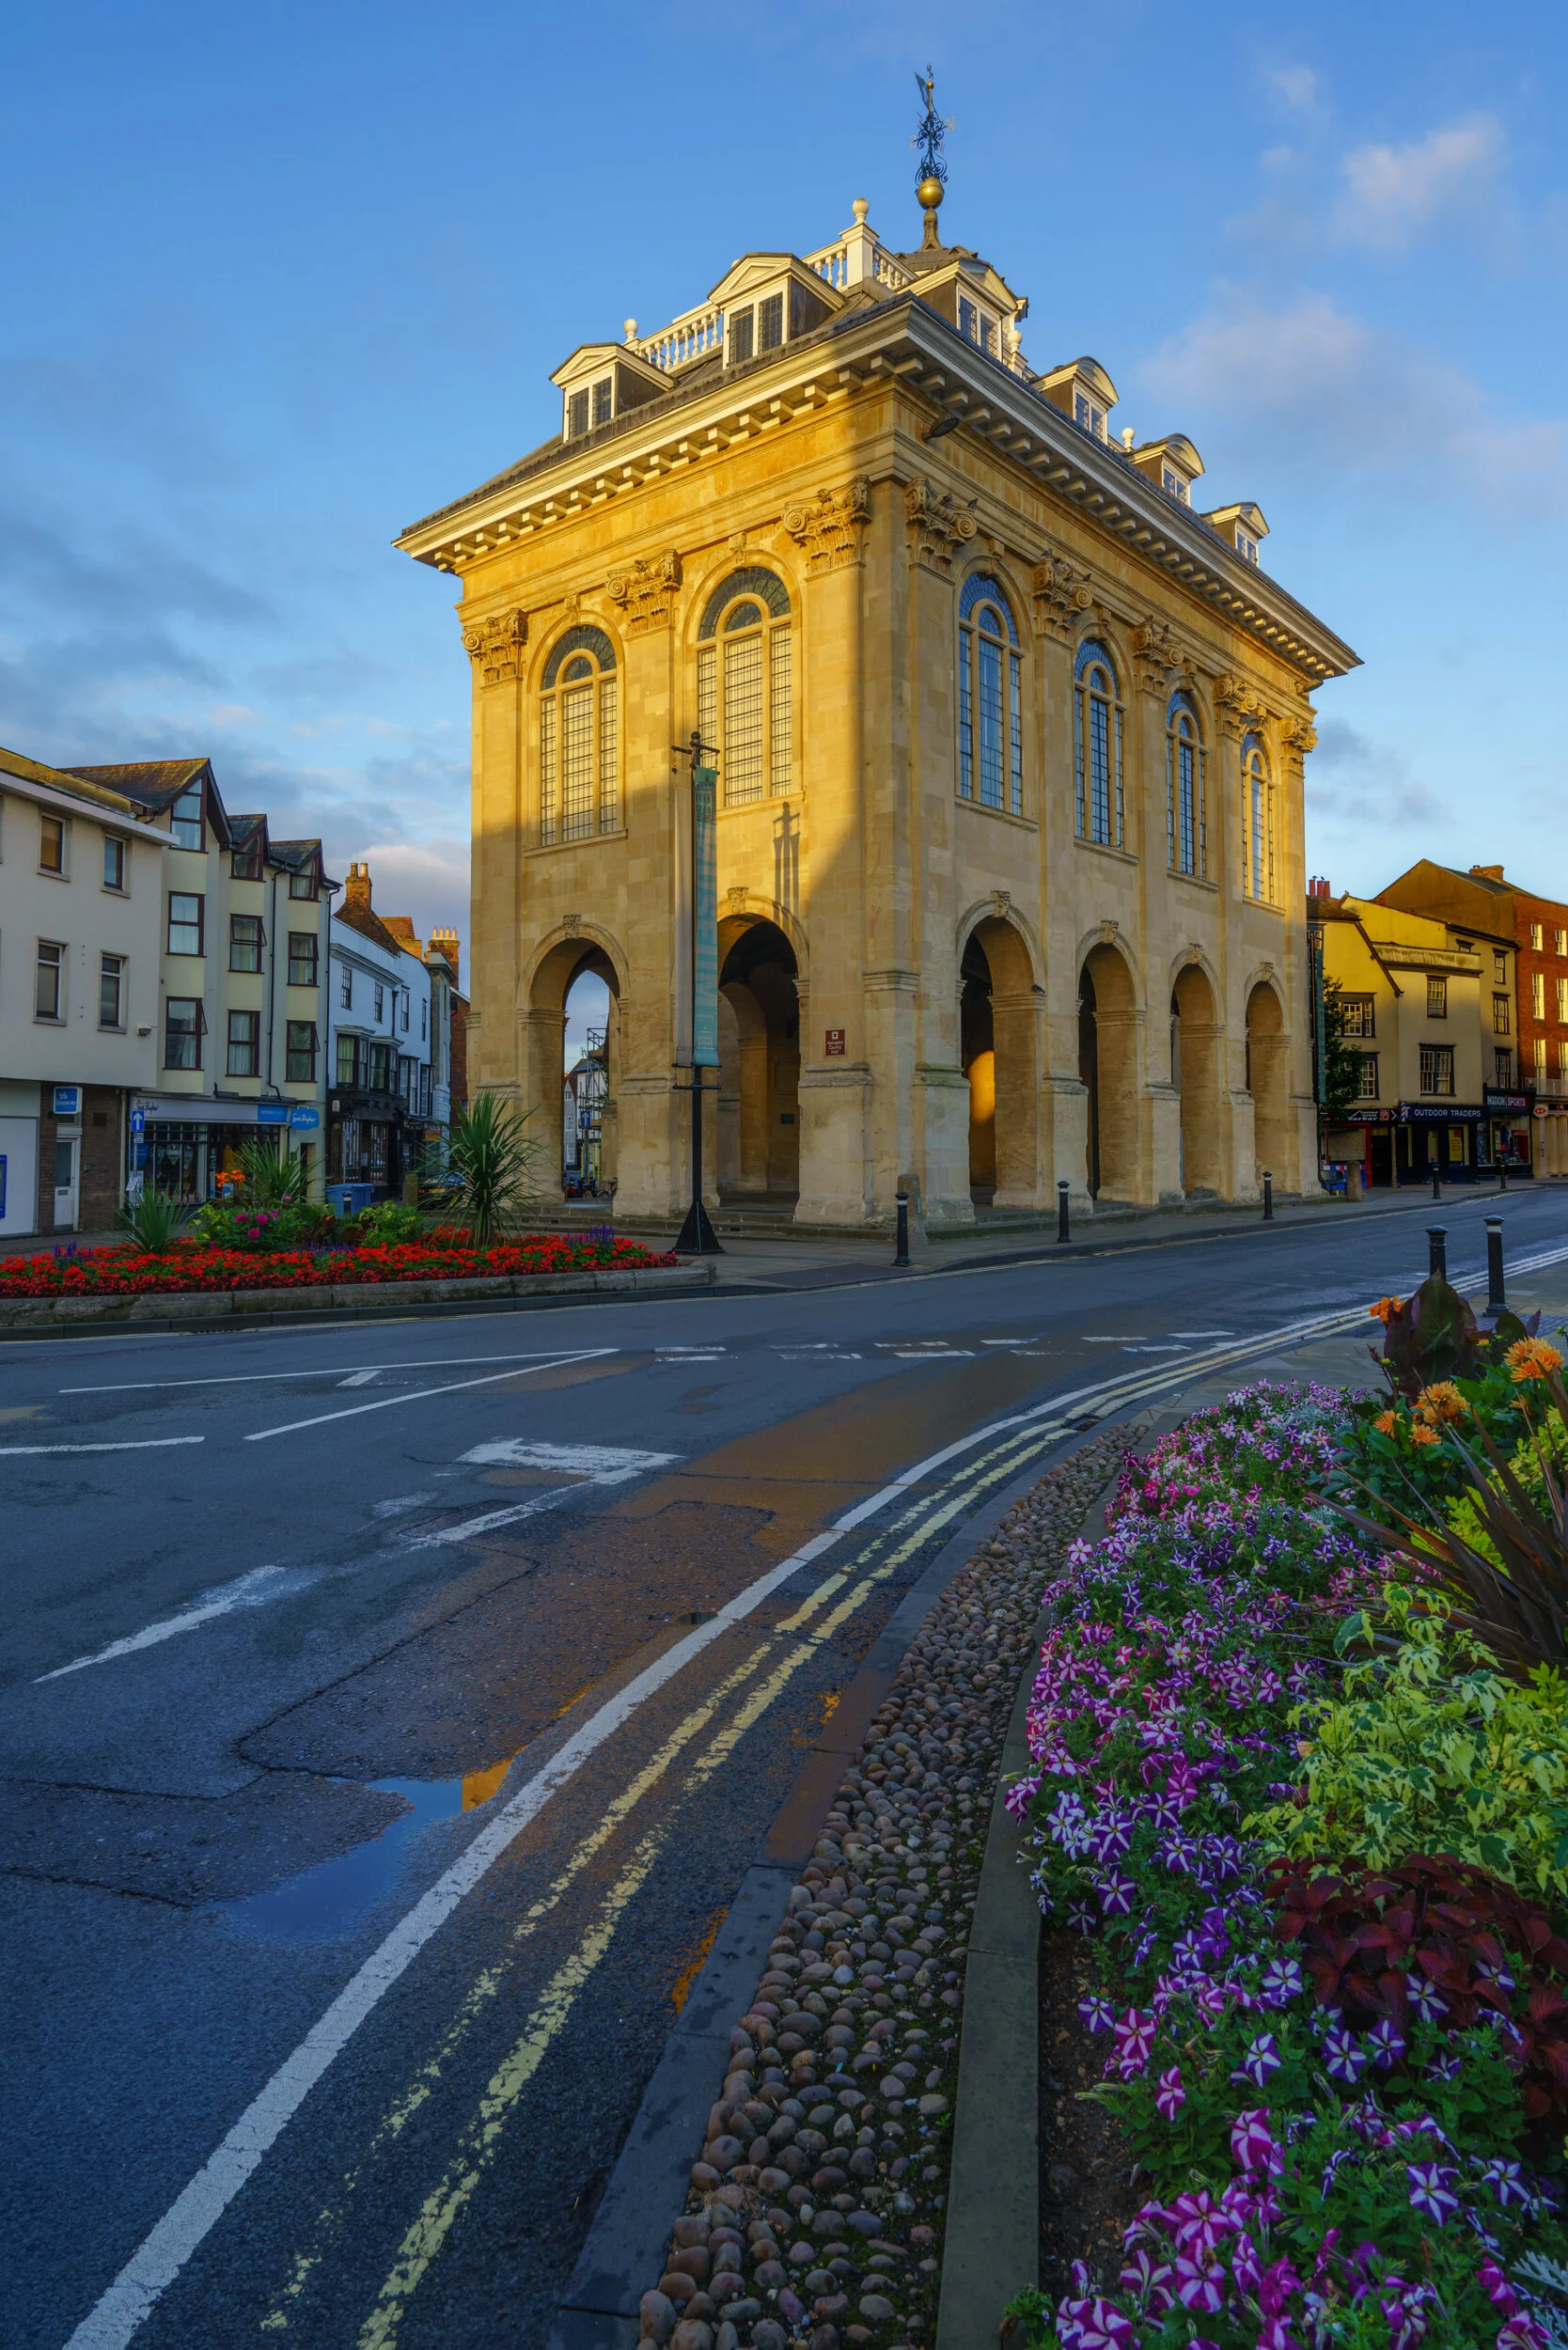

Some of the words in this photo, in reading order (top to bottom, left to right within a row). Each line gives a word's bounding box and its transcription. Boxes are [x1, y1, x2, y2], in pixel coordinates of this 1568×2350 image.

[697, 824, 717, 1007] MUSEUM
[1508, 1097, 1527, 1107] SPORTS
[145, 1101, 159, 1115] Ryder
[1414, 1108, 1448, 1117] OUTDOOR
[1450, 1109, 1482, 1118] TRADERS
[302, 1114, 317, 1124] Ryder
